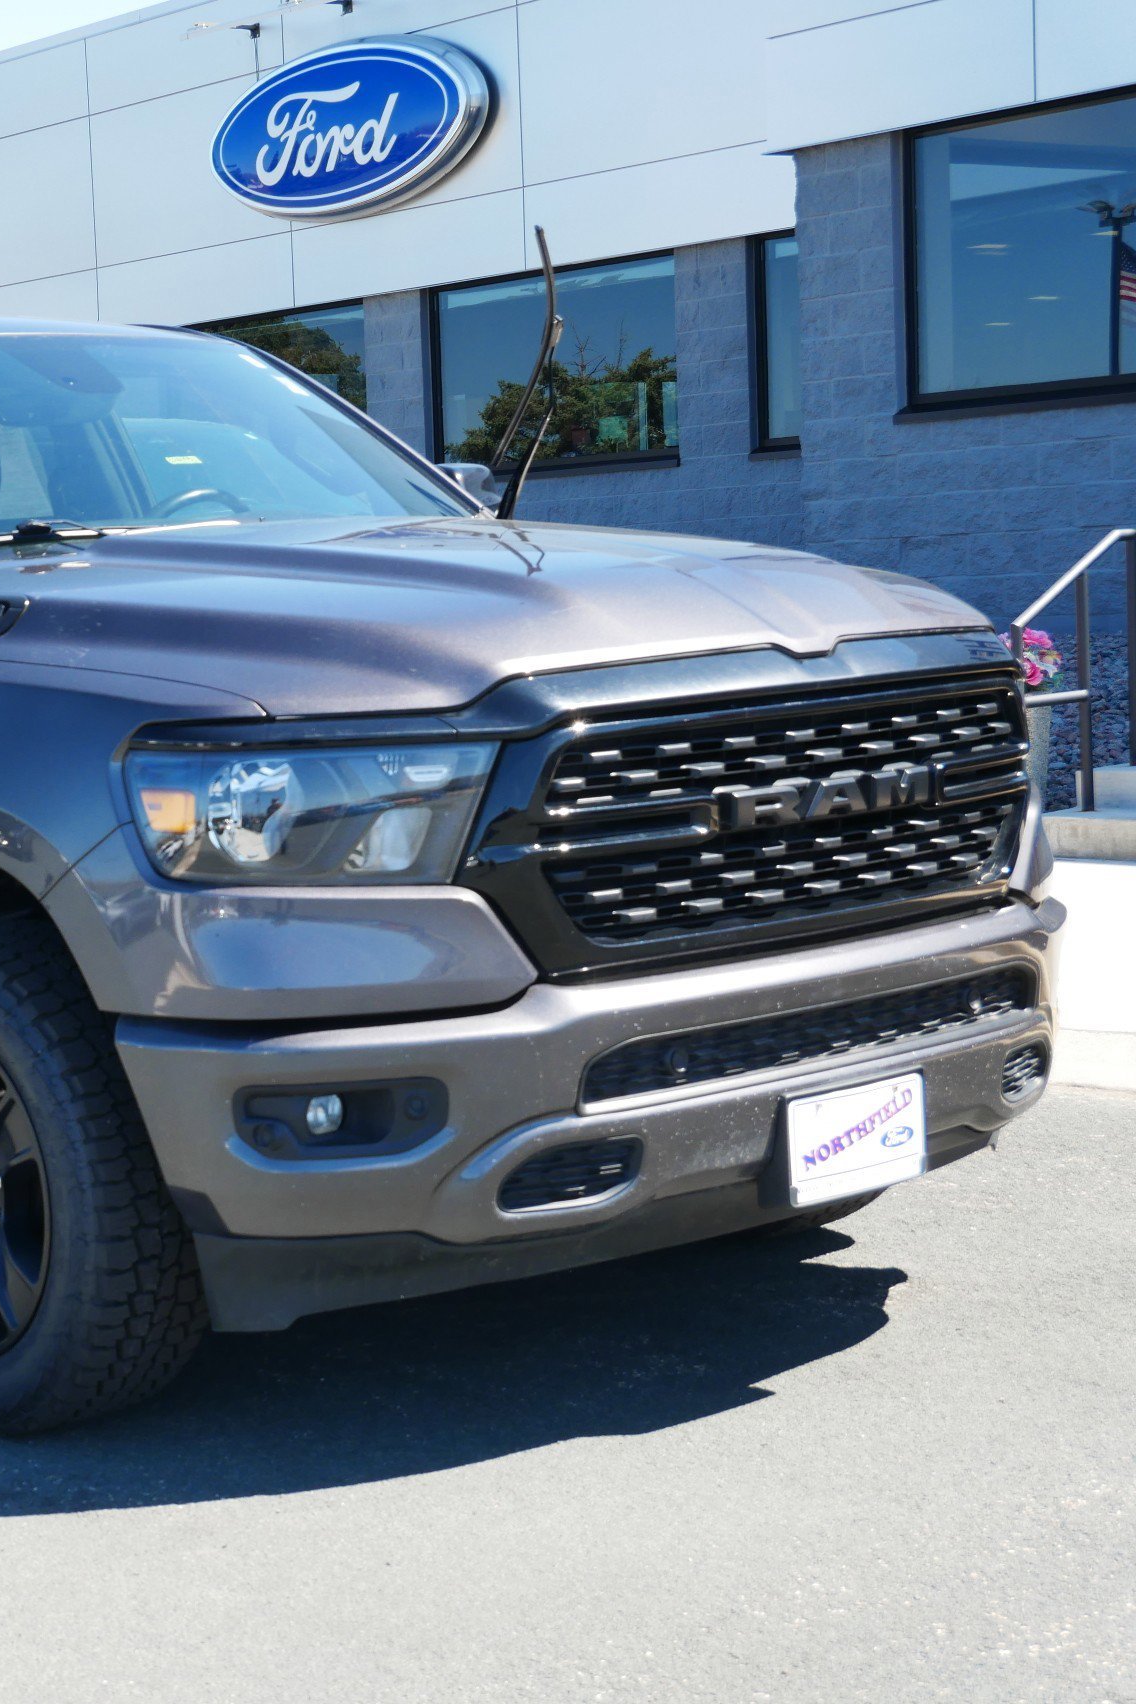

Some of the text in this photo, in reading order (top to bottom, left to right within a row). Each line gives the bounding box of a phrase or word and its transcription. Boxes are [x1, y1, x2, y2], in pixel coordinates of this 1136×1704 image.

[256, 80, 399, 186] Ford
[719, 765, 930, 829] RAM
[801, 1087, 913, 1172] NORTHFIELD
